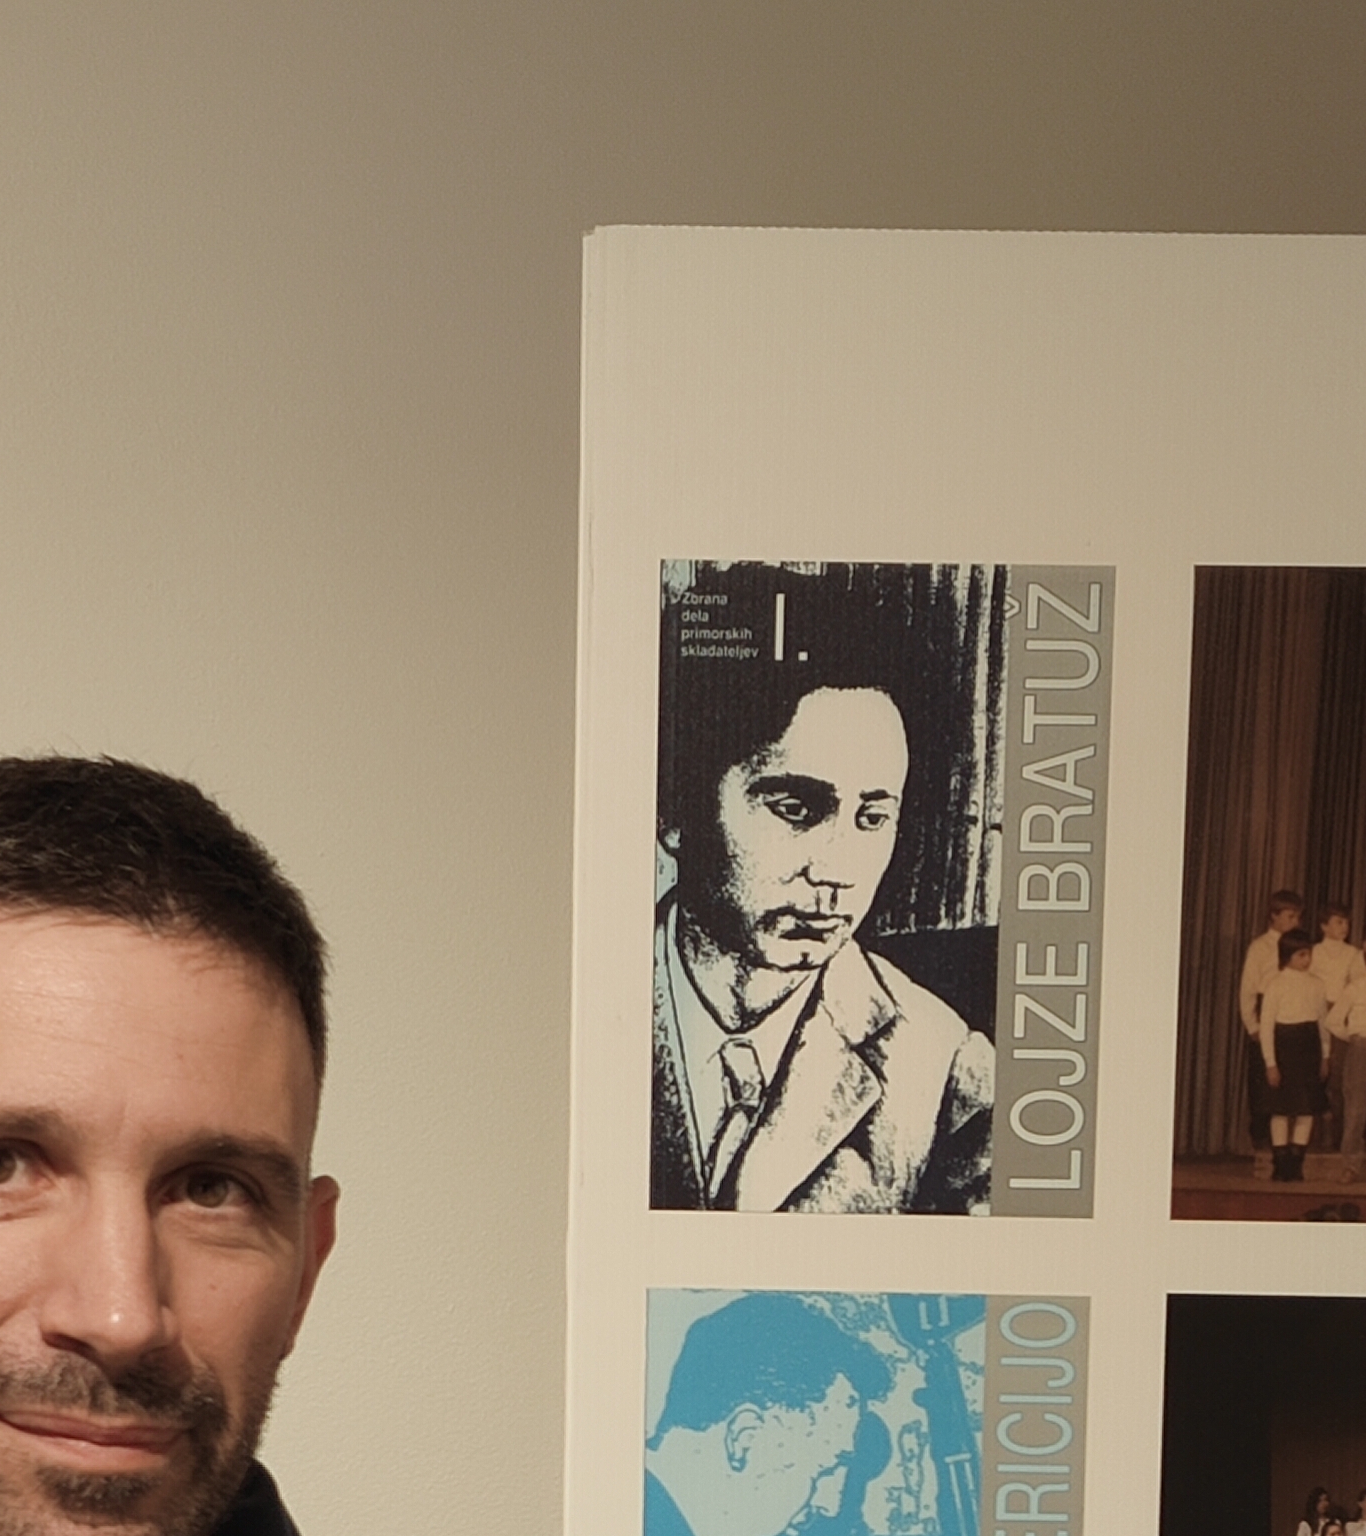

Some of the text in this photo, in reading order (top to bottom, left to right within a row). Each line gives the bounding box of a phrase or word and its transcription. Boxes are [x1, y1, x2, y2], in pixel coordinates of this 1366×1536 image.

[681, 592, 728, 605] Zbrana
[681, 609, 709, 622] dela
[681, 627, 753, 642] primorskih
[680, 644, 760, 660] skladateljev
[1002, 582, 1101, 1192] LOJZE BRATUŽ
